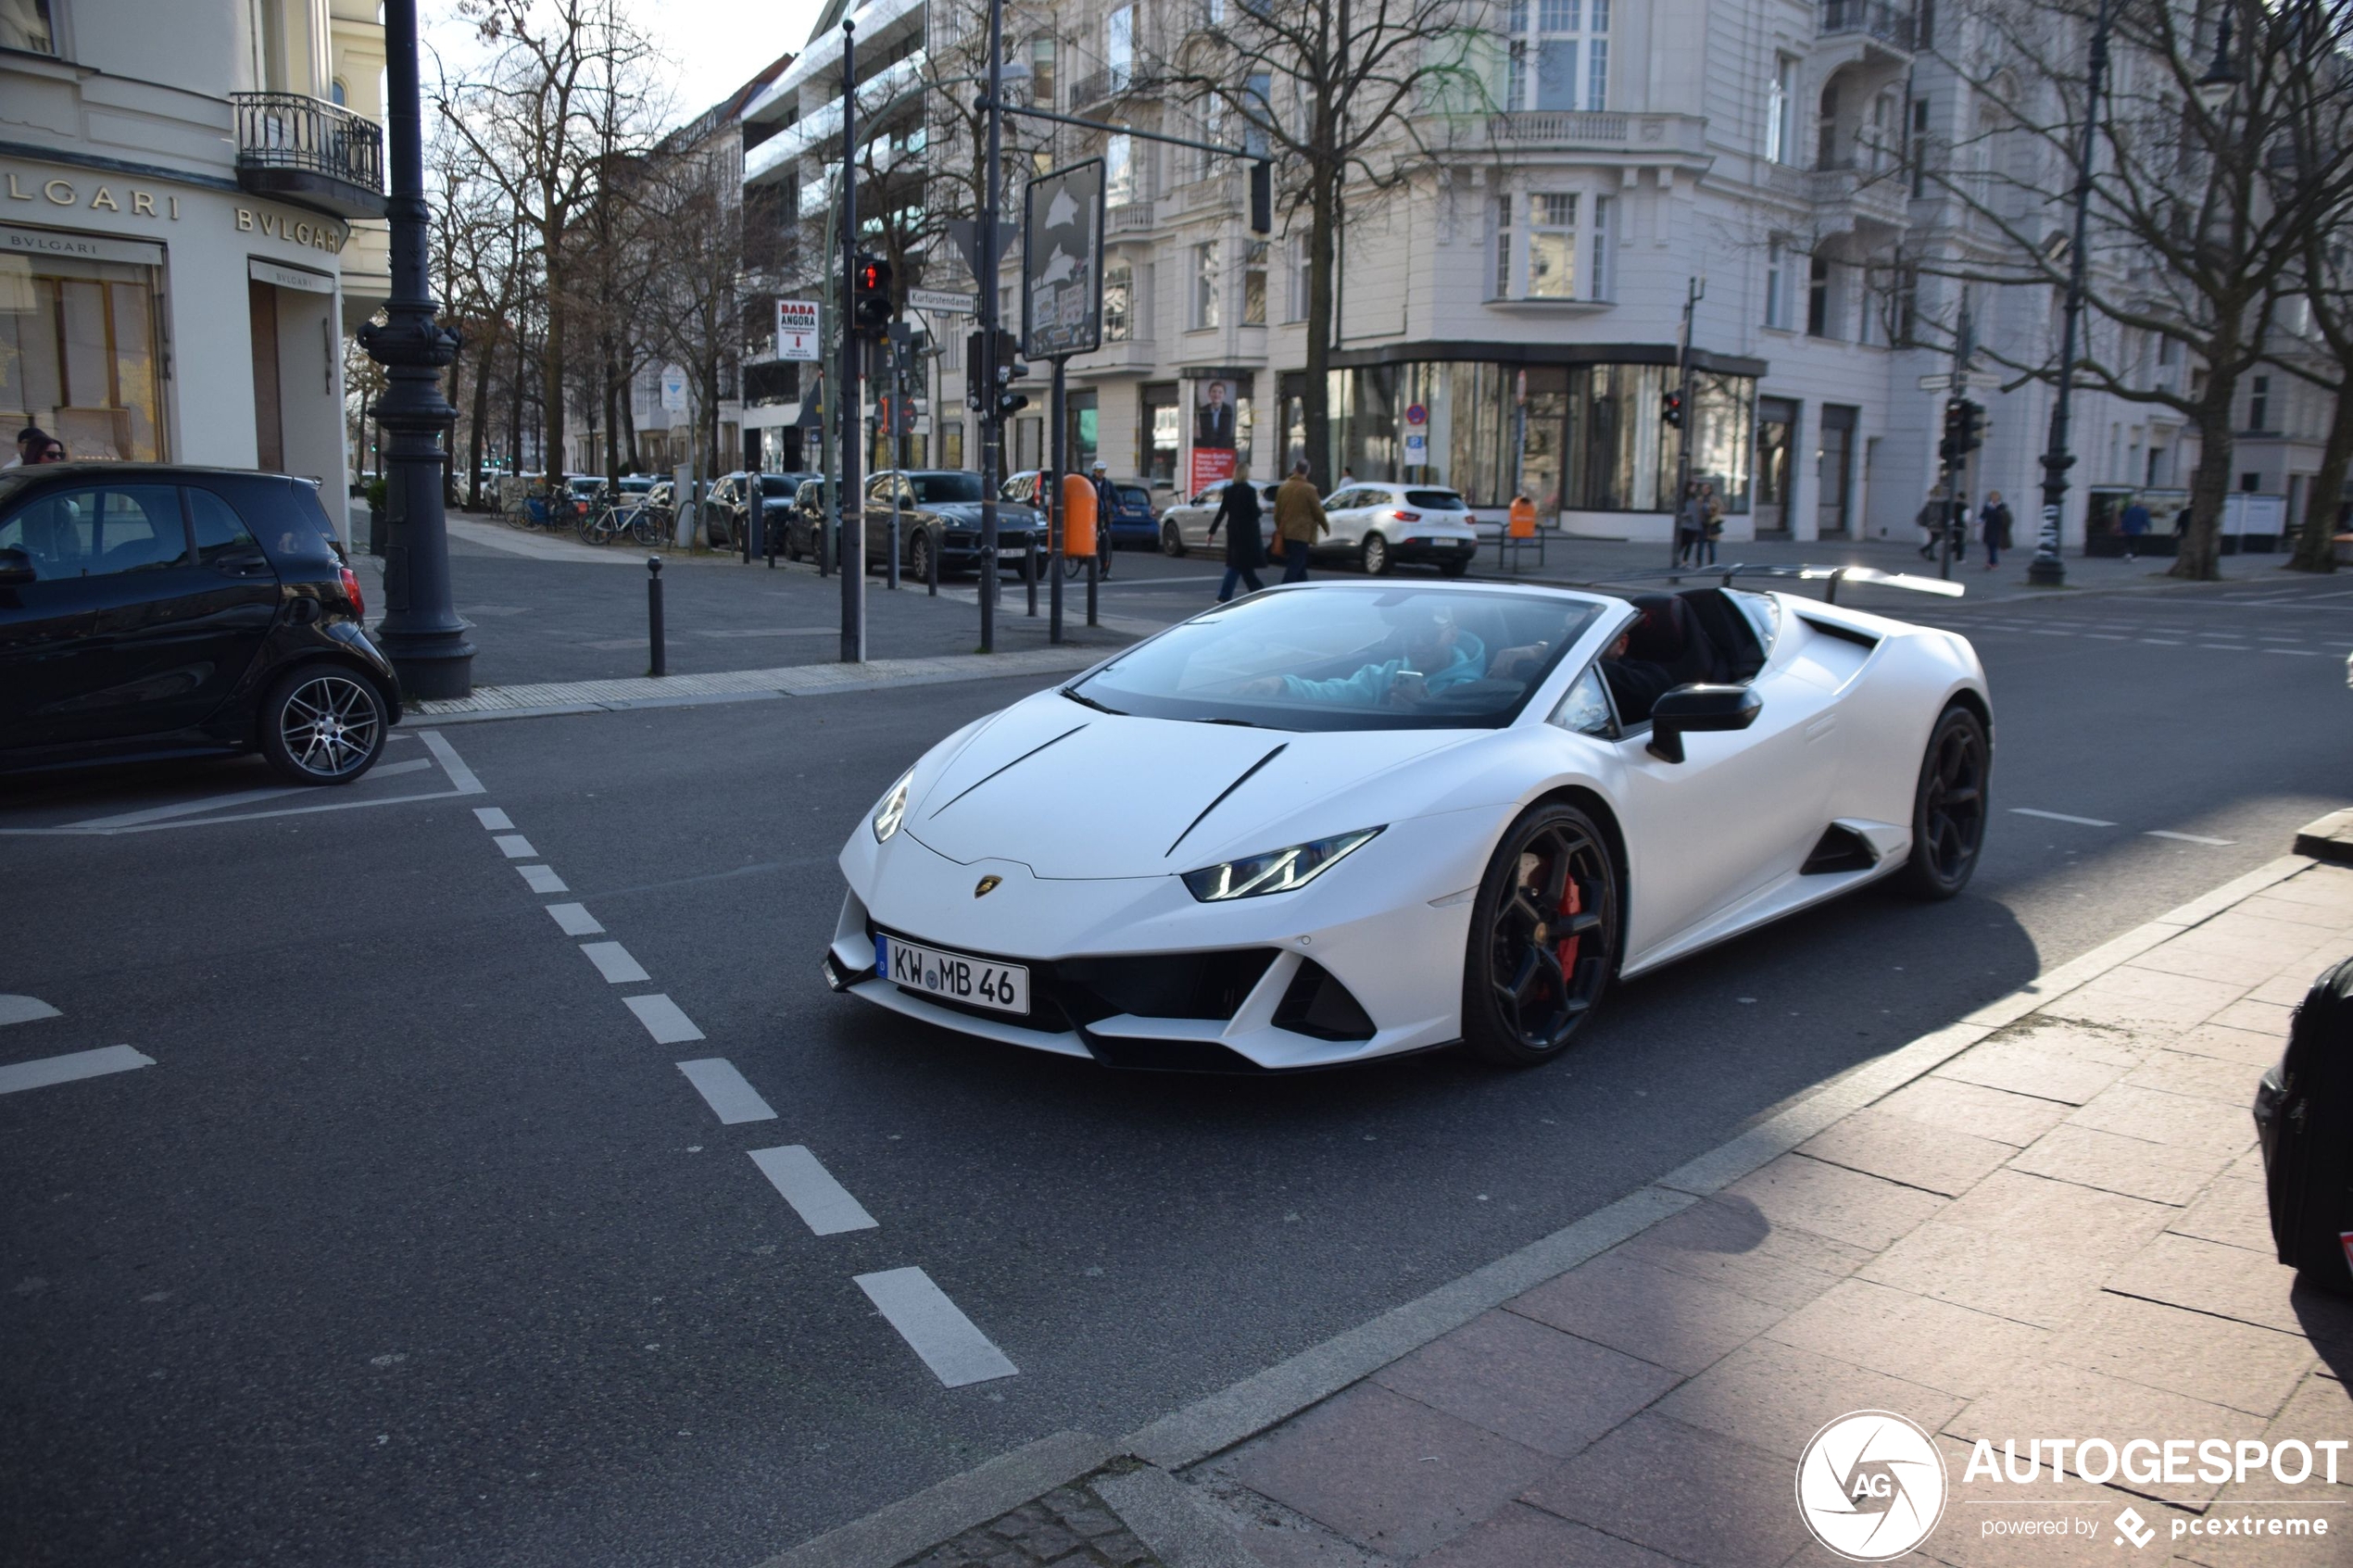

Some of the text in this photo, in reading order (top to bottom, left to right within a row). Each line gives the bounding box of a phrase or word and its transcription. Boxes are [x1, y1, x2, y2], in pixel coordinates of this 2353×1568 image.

[234, 207, 340, 255] BVLGARI
[11, 235, 97, 254] BVLGARI
[912, 292, 972, 307] Kurfürstendamm
[781, 304, 815, 315] BABA
[781, 315, 815, 326] ANGORA
[895, 946, 1014, 1005] KW MB 46
